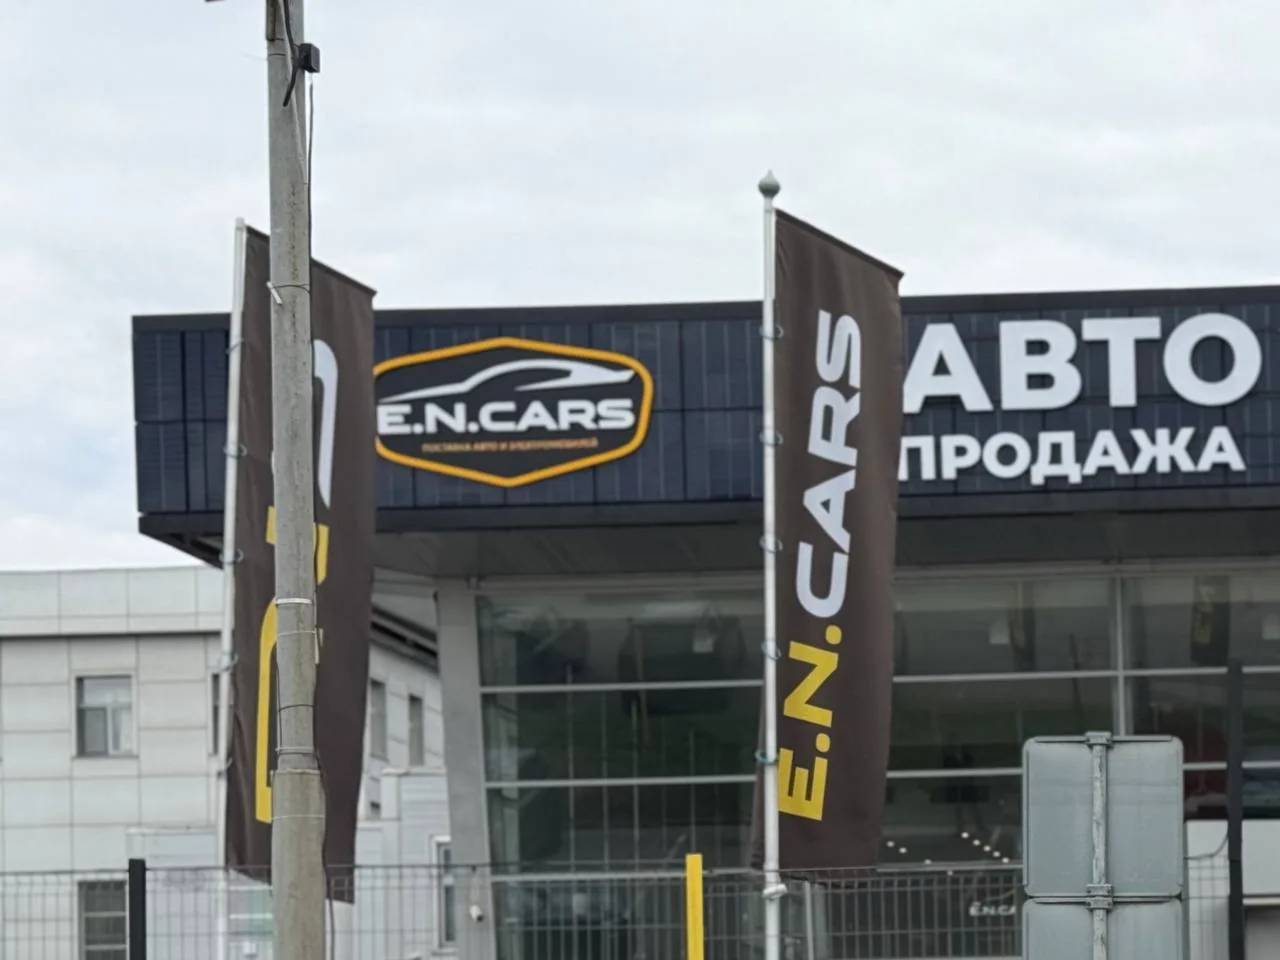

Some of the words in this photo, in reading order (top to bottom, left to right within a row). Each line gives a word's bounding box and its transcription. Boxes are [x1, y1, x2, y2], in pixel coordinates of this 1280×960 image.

[903, 313, 1261, 413] АВТО
[376, 399, 636, 435] E.N.CARS
[898, 427, 1245, 485] ПРОДАЖА
[778, 309, 862, 821] E.N.CARS
